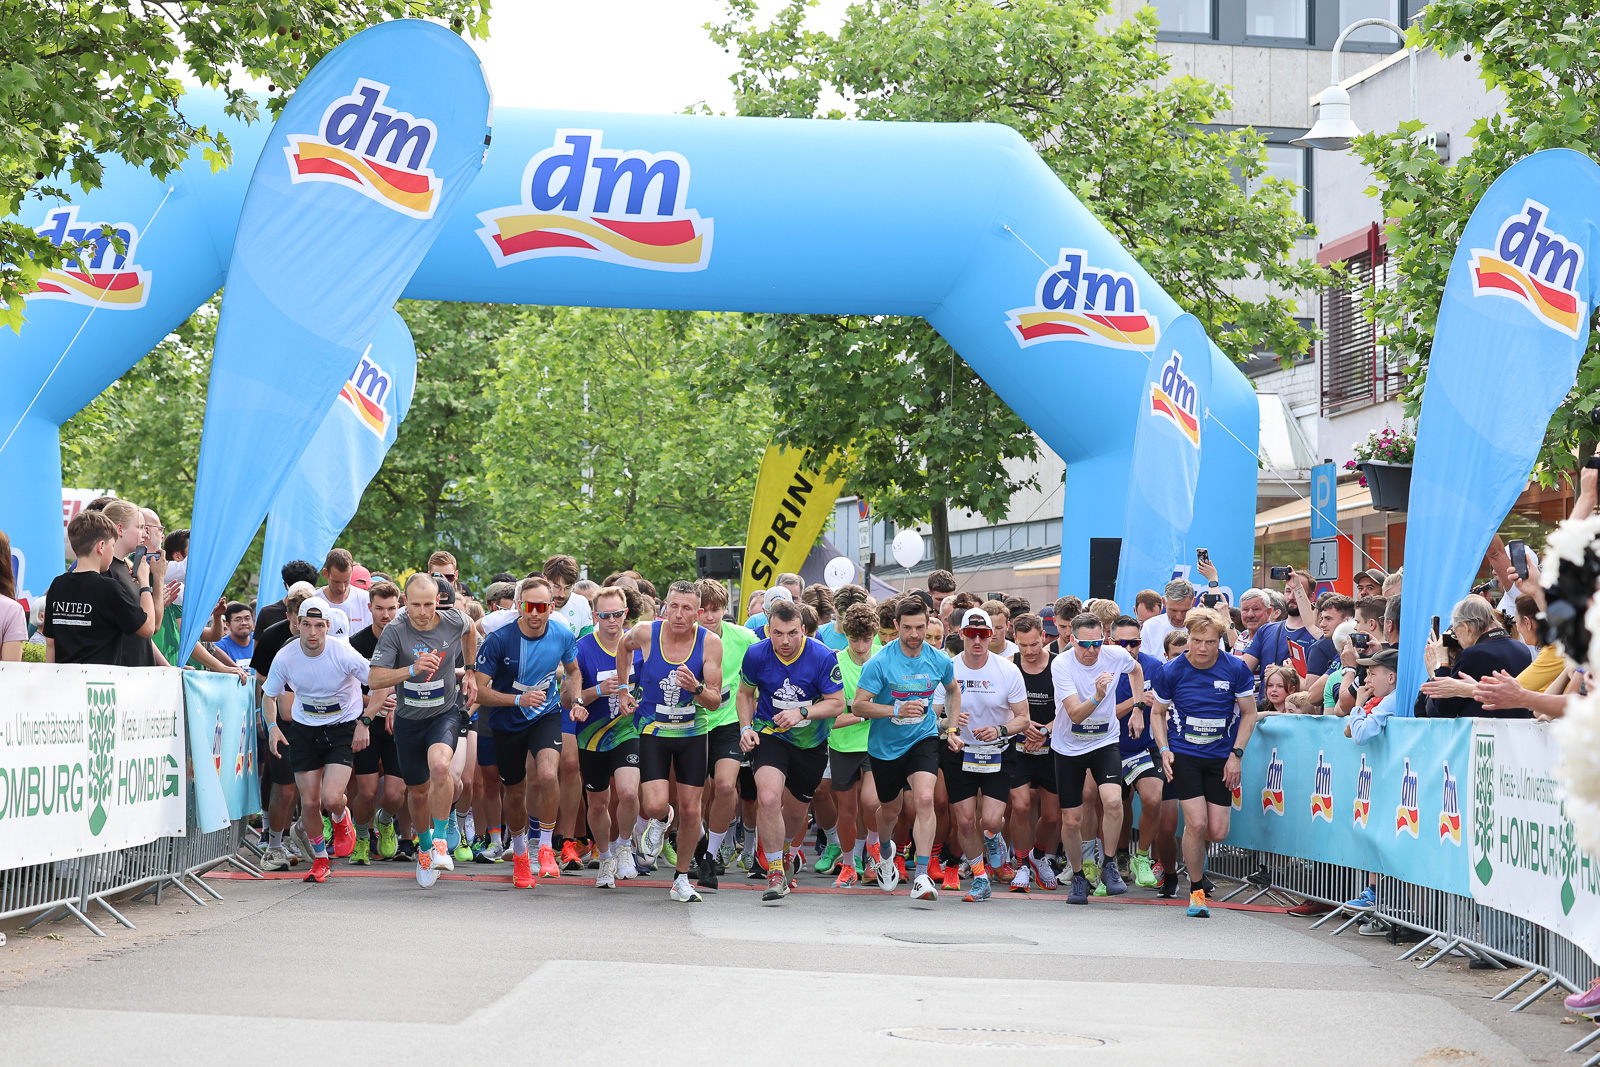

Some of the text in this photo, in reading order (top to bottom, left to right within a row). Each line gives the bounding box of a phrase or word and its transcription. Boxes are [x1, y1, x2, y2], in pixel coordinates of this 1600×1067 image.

[326, 87, 431, 171] dm
[531, 136, 680, 216] dm
[1500, 207, 1579, 291] dm
[1042, 255, 1135, 313] dm
[348, 359, 388, 406] m
[1162, 355, 1197, 415] dm
[1317, 475, 1330, 529] P
[16, 712, 84, 746] Universitätsstadt
[0, 763, 84, 821] OMBURG
[1267, 752, 1283, 790] dm
[1316, 754, 1331, 795] dm
[1358, 758, 1372, 801] dm
[1402, 762, 1417, 808] dm
[1444, 766, 1458, 814] dm
[1500, 815, 1559, 880] HOMBUR
